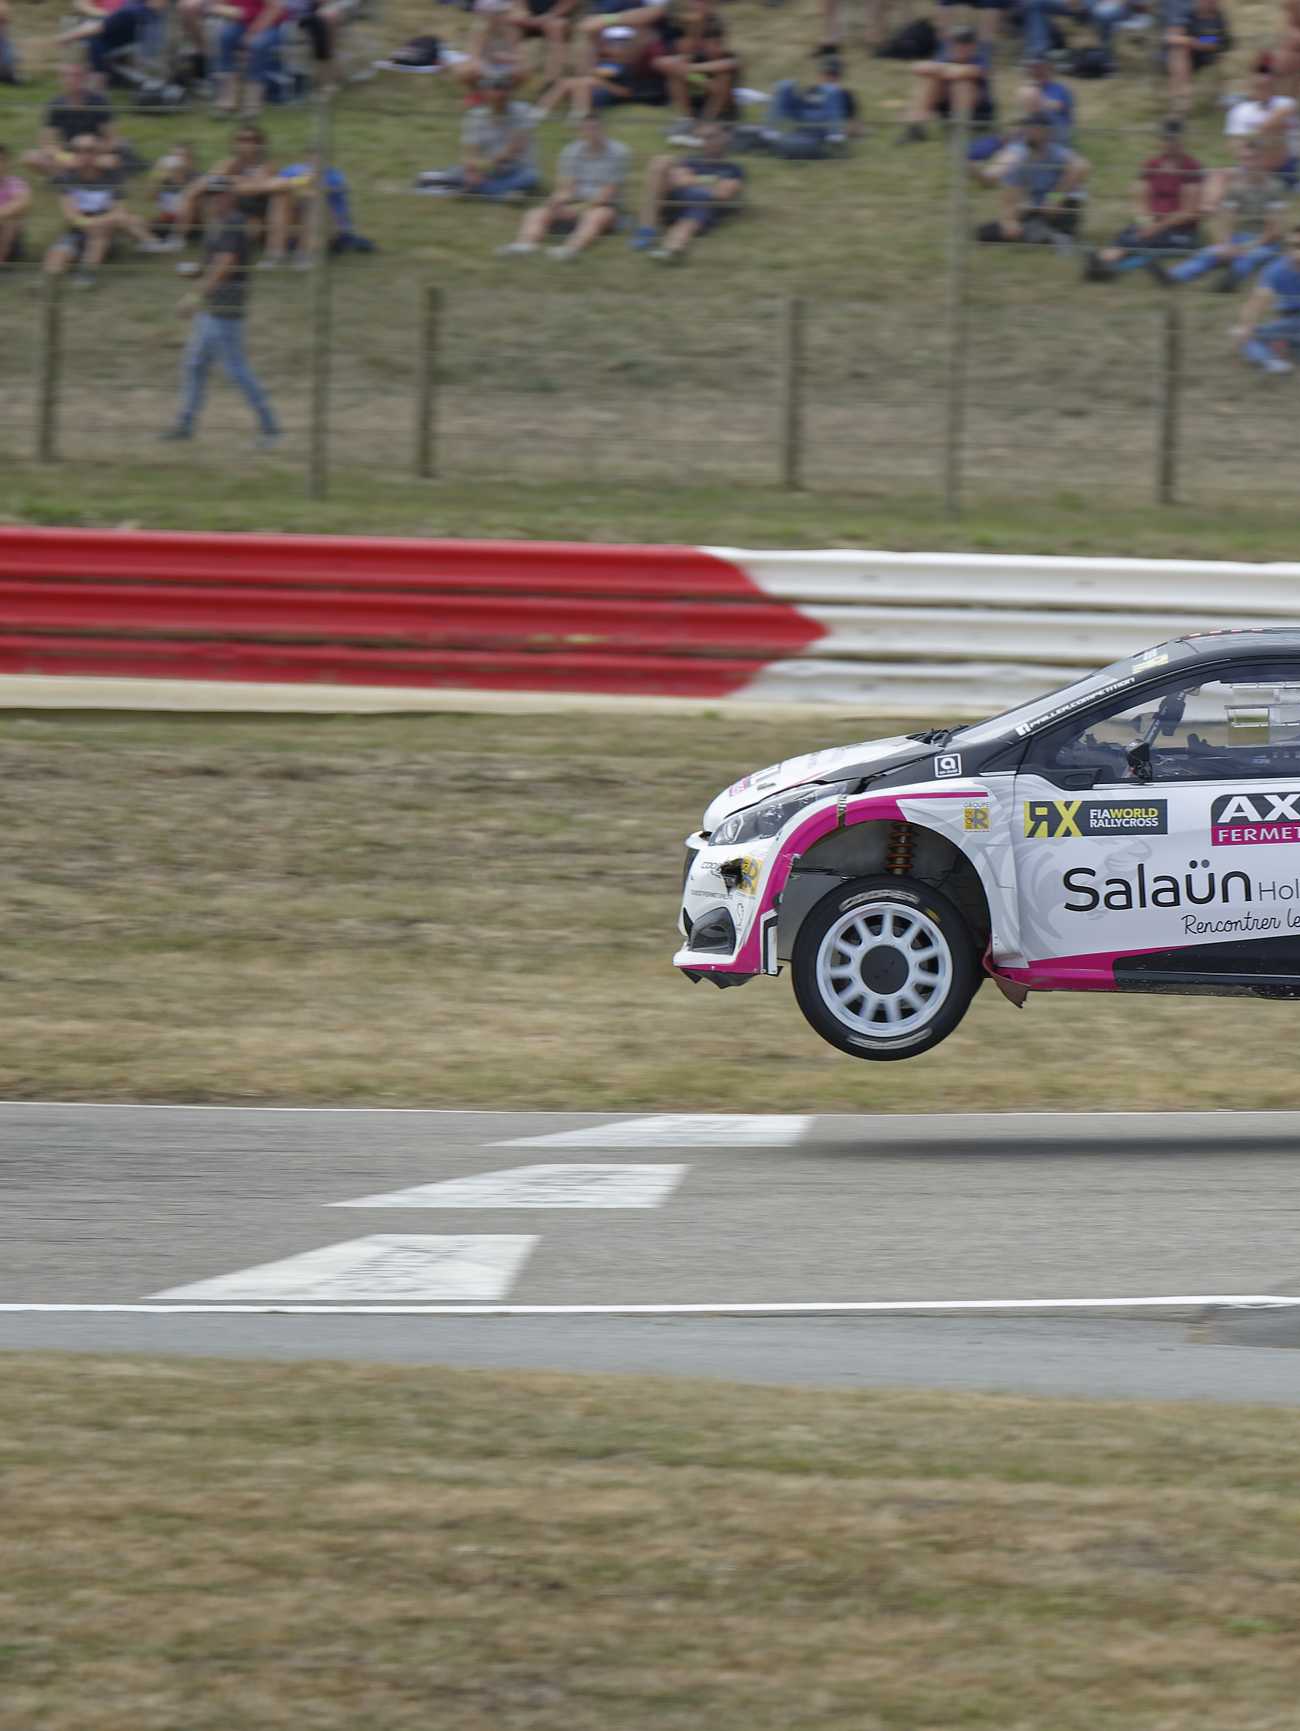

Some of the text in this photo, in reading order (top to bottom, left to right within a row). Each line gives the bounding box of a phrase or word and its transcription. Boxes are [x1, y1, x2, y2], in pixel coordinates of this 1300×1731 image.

[1089, 818, 1159, 828] RALLYCROSS
[1063, 859, 1251, 912] Salaün
[1181, 911, 1281, 935] Rencontrer
